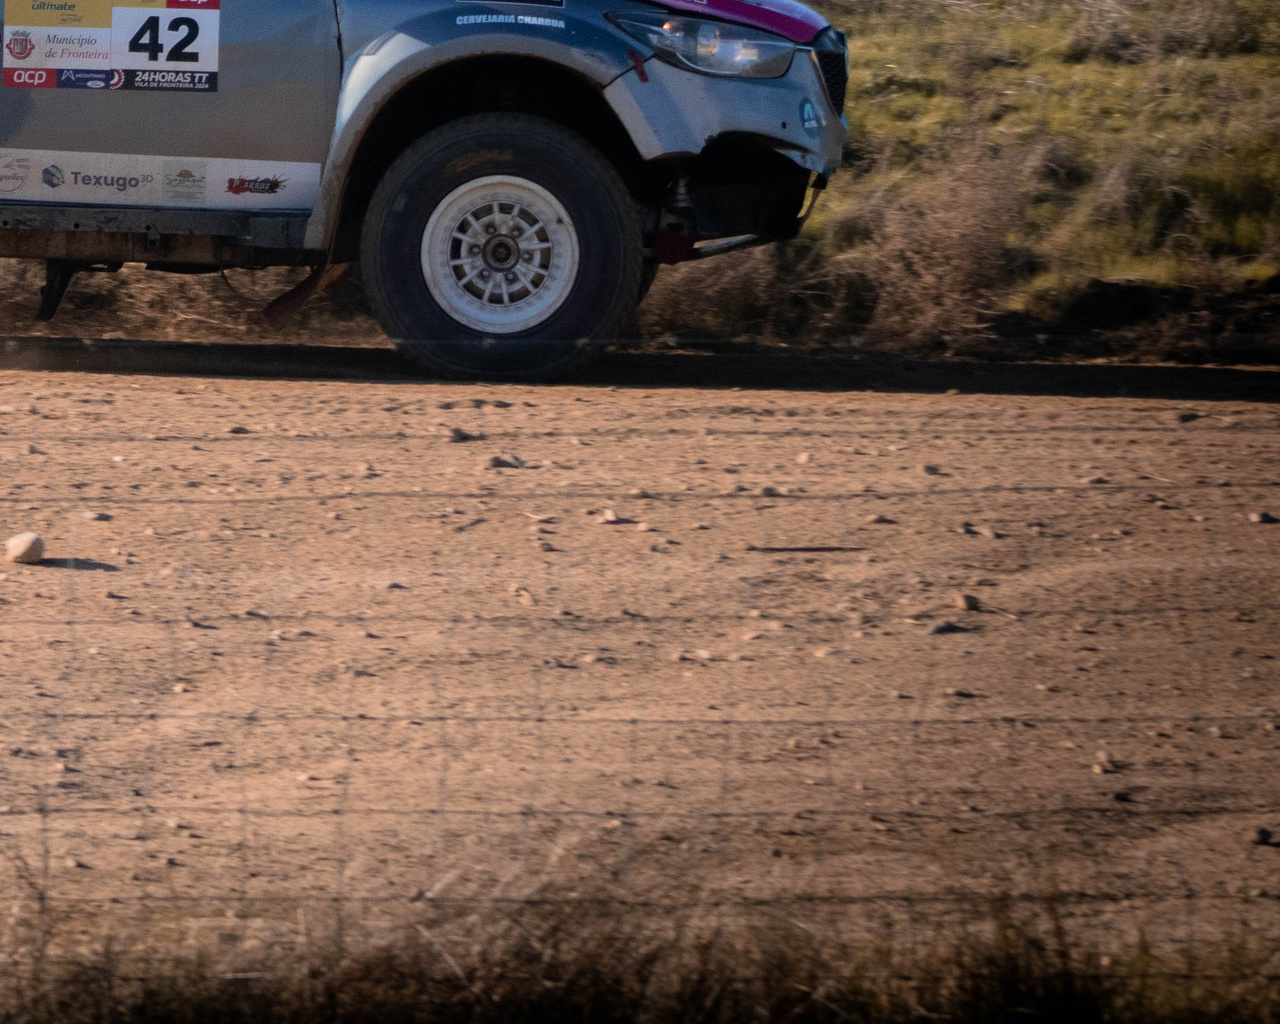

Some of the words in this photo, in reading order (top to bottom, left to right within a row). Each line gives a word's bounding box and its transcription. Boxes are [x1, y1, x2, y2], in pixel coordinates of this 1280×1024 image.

[31, 1, 76, 11] ultimate
[456, 15, 516, 25] CERVEJARIA
[517, 15, 565, 29] CHARRUA
[45, 34, 98, 48] Município
[129, 16, 200, 62] 42
[44, 48, 58, 58] de
[60, 48, 109, 60] Fronteira
[13, 70, 47, 86] acp
[192, 73, 209, 83] TT
